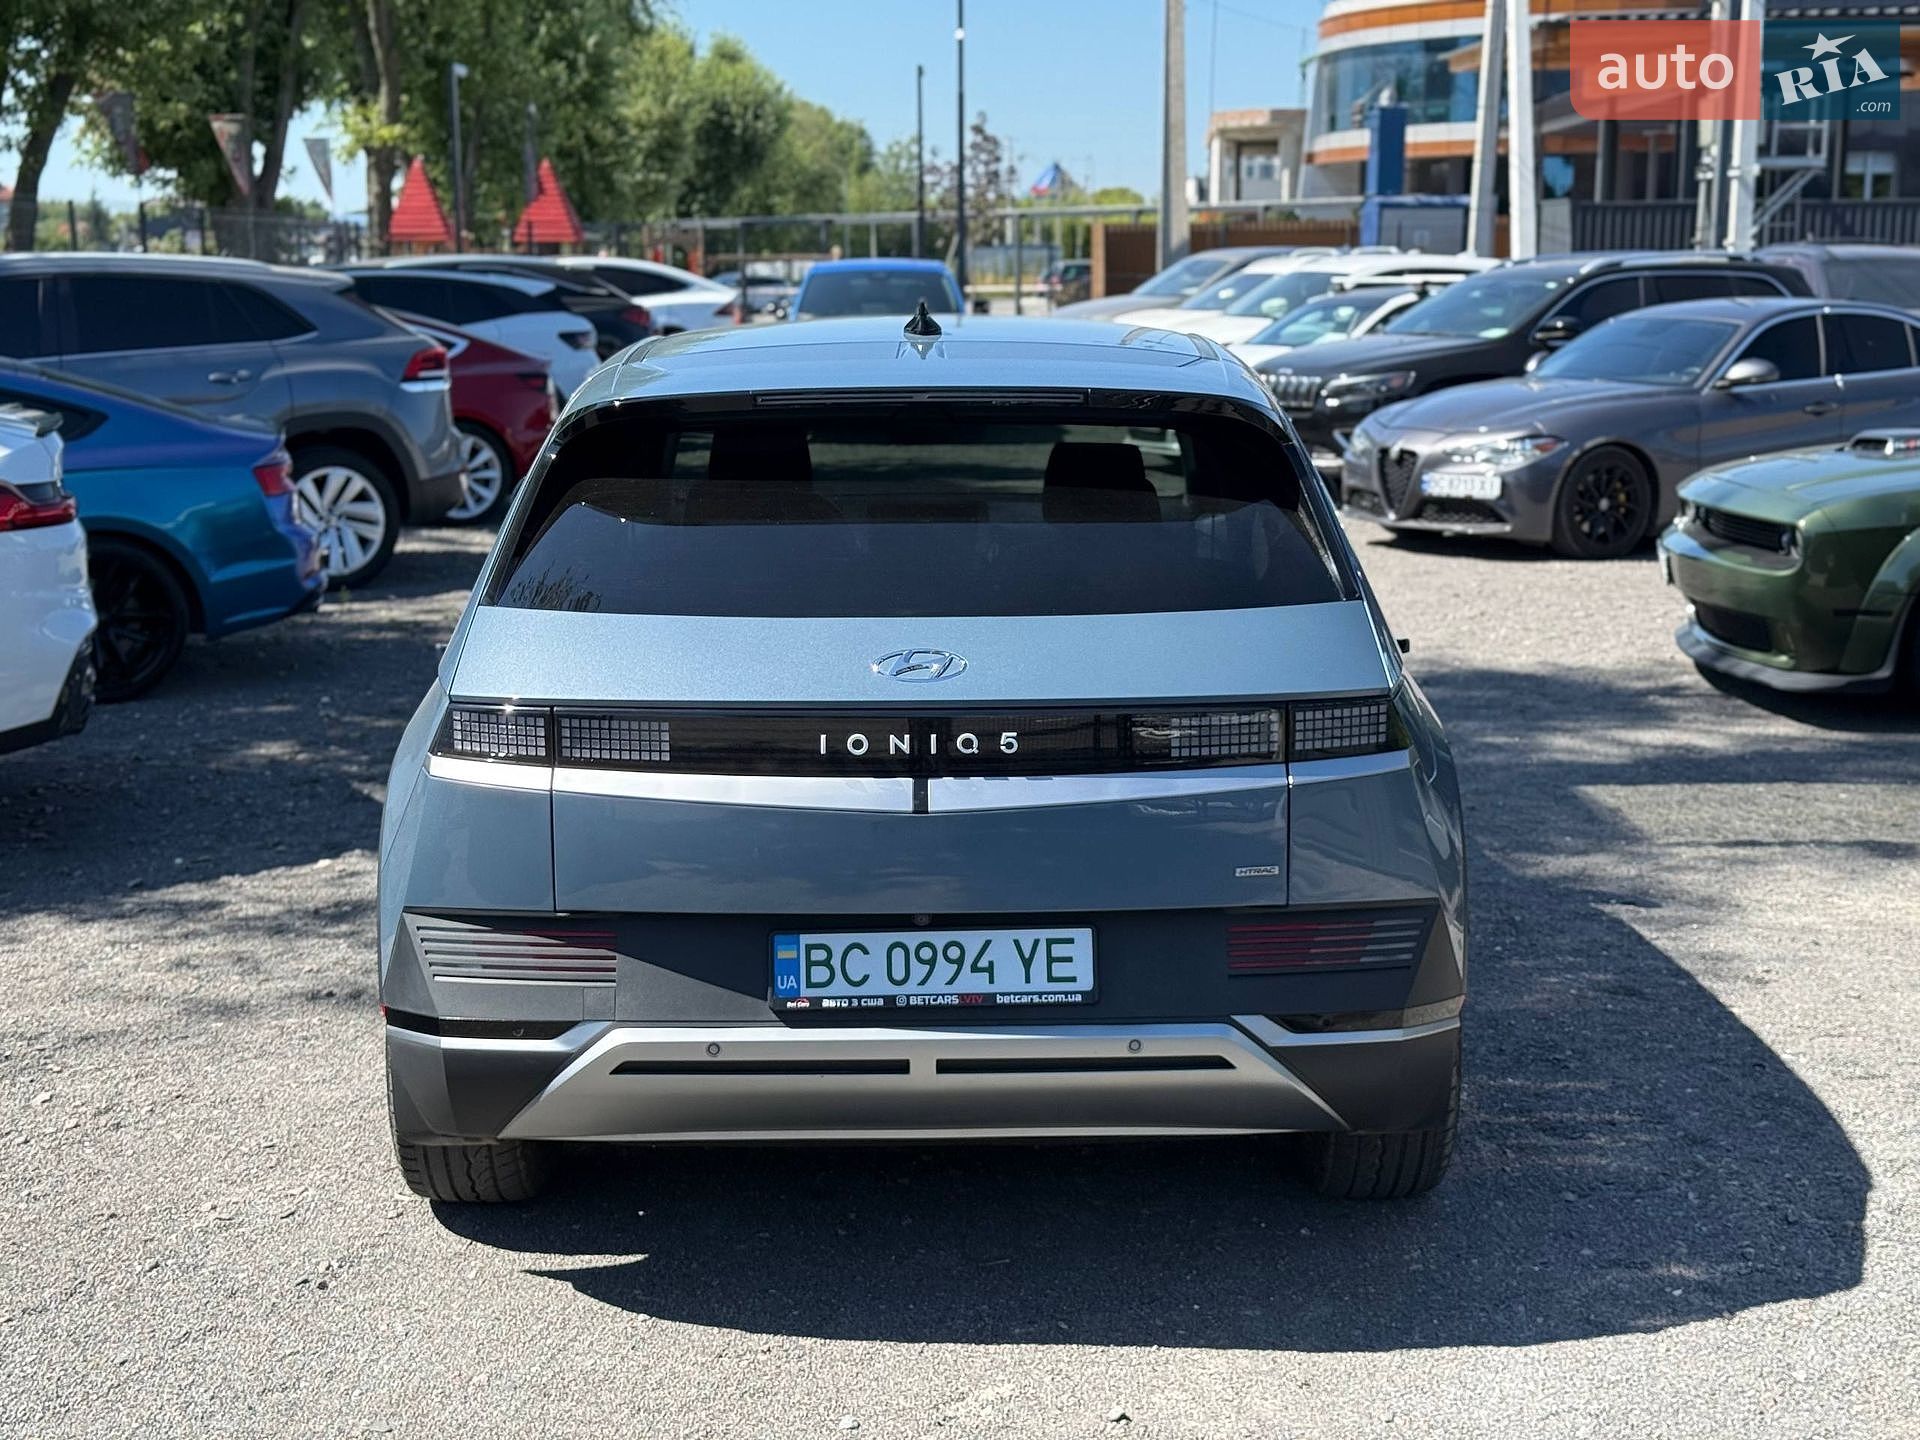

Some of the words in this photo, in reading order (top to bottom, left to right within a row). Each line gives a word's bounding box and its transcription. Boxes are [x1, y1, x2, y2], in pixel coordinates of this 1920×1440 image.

[819, 732, 980, 757] IONIQ
[999, 731, 1019, 755] 5
[1238, 866, 1277, 876] HTRAC
[804, 942, 871, 989] BC
[886, 939, 995, 986] 0994
[1013, 937, 1077, 984] YE
[777, 975, 798, 990] UA
[996, 993, 1082, 1004] betcars.com.ua
